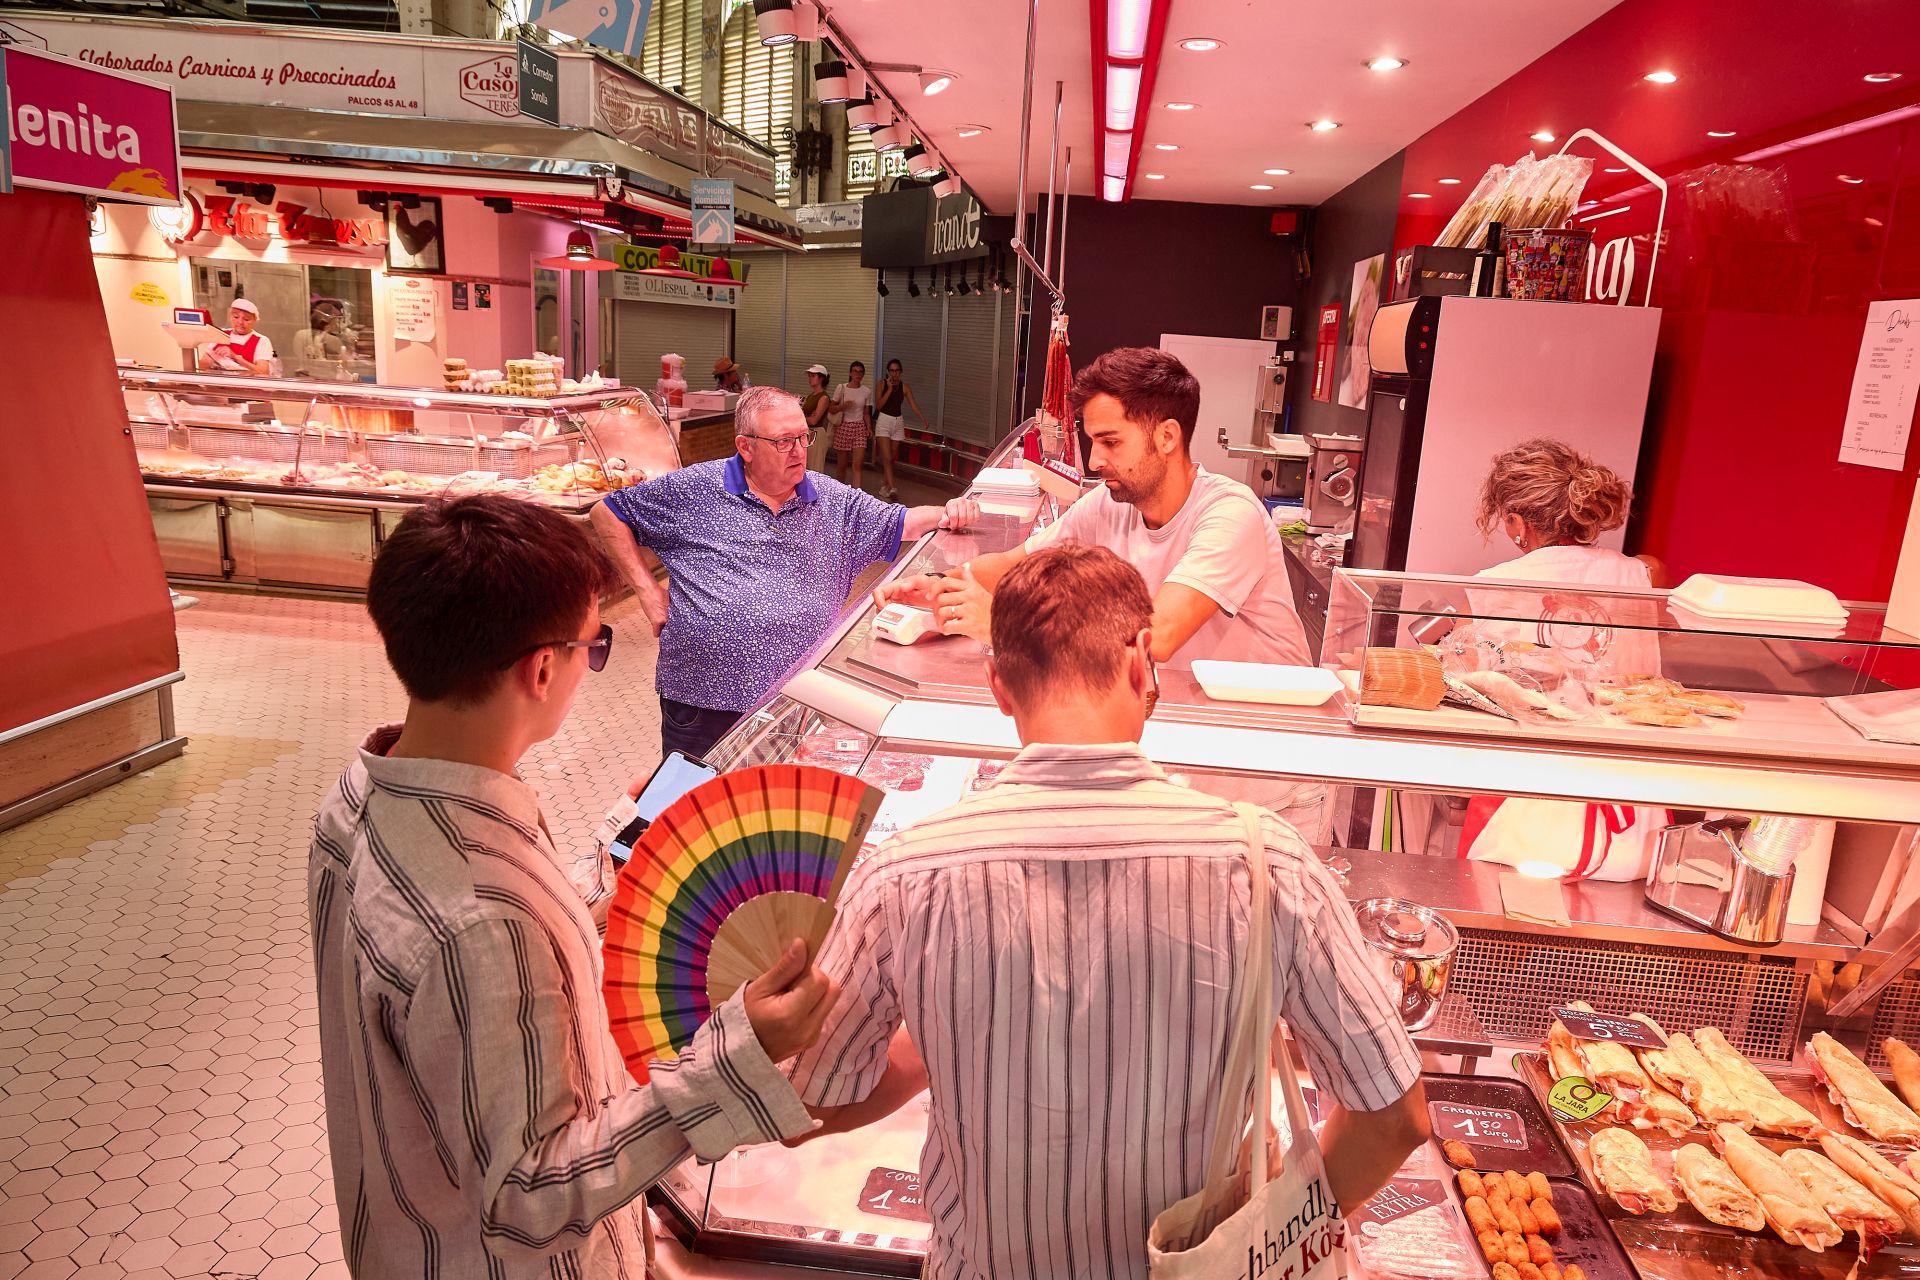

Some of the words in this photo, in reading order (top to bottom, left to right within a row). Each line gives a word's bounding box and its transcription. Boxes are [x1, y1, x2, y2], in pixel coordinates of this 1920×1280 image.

[79, 49, 173, 73] Elaborados
[179, 55, 256, 80] Carnicos
[261, 66, 274, 86] y
[279, 62, 397, 90] Precocinados
[494, 62, 512, 78] La
[532, 63, 554, 83] Corredor
[348, 96, 382, 107] PALCOS
[384, 98, 394, 108] 45
[395, 99, 407, 109] AL
[408, 100, 418, 109] 48
[530, 88, 549, 105] Sorolla
[486, 100, 519, 113] TERES
[693, 184, 725, 194] Servicio
[694, 194, 730, 205] domicilio
[1553, 1092, 1566, 1103] LA
[1566, 1099, 1589, 1114] JARA
[1441, 1106, 1512, 1120] CROQUETAS
[868, 1189, 894, 1210] 1
[1364, 1183, 1403, 1208] UET
[1369, 1193, 1432, 1220] EXTRA
